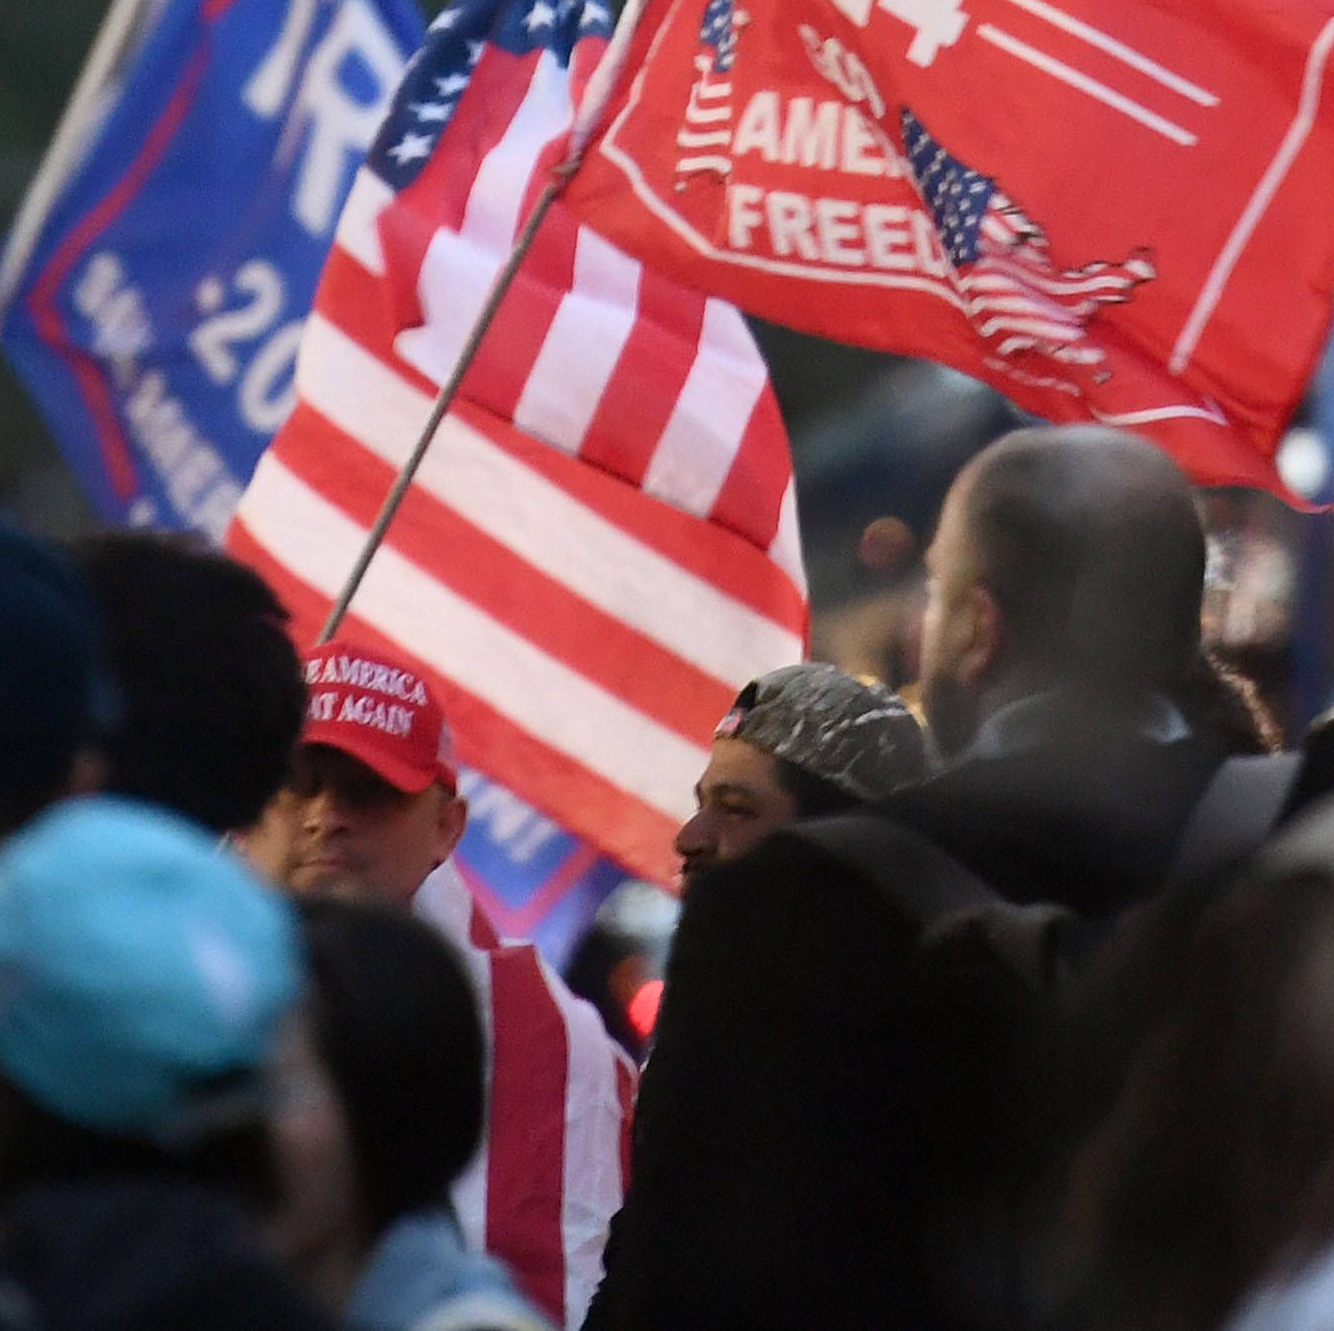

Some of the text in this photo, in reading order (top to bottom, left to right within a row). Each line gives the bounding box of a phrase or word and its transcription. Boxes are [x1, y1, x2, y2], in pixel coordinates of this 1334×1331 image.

[727, 184, 951, 276] FREE
[188, 259, 305, 435] 20
[319, 654, 428, 706] AMERICA
[336, 693, 415, 736] AGAIN
